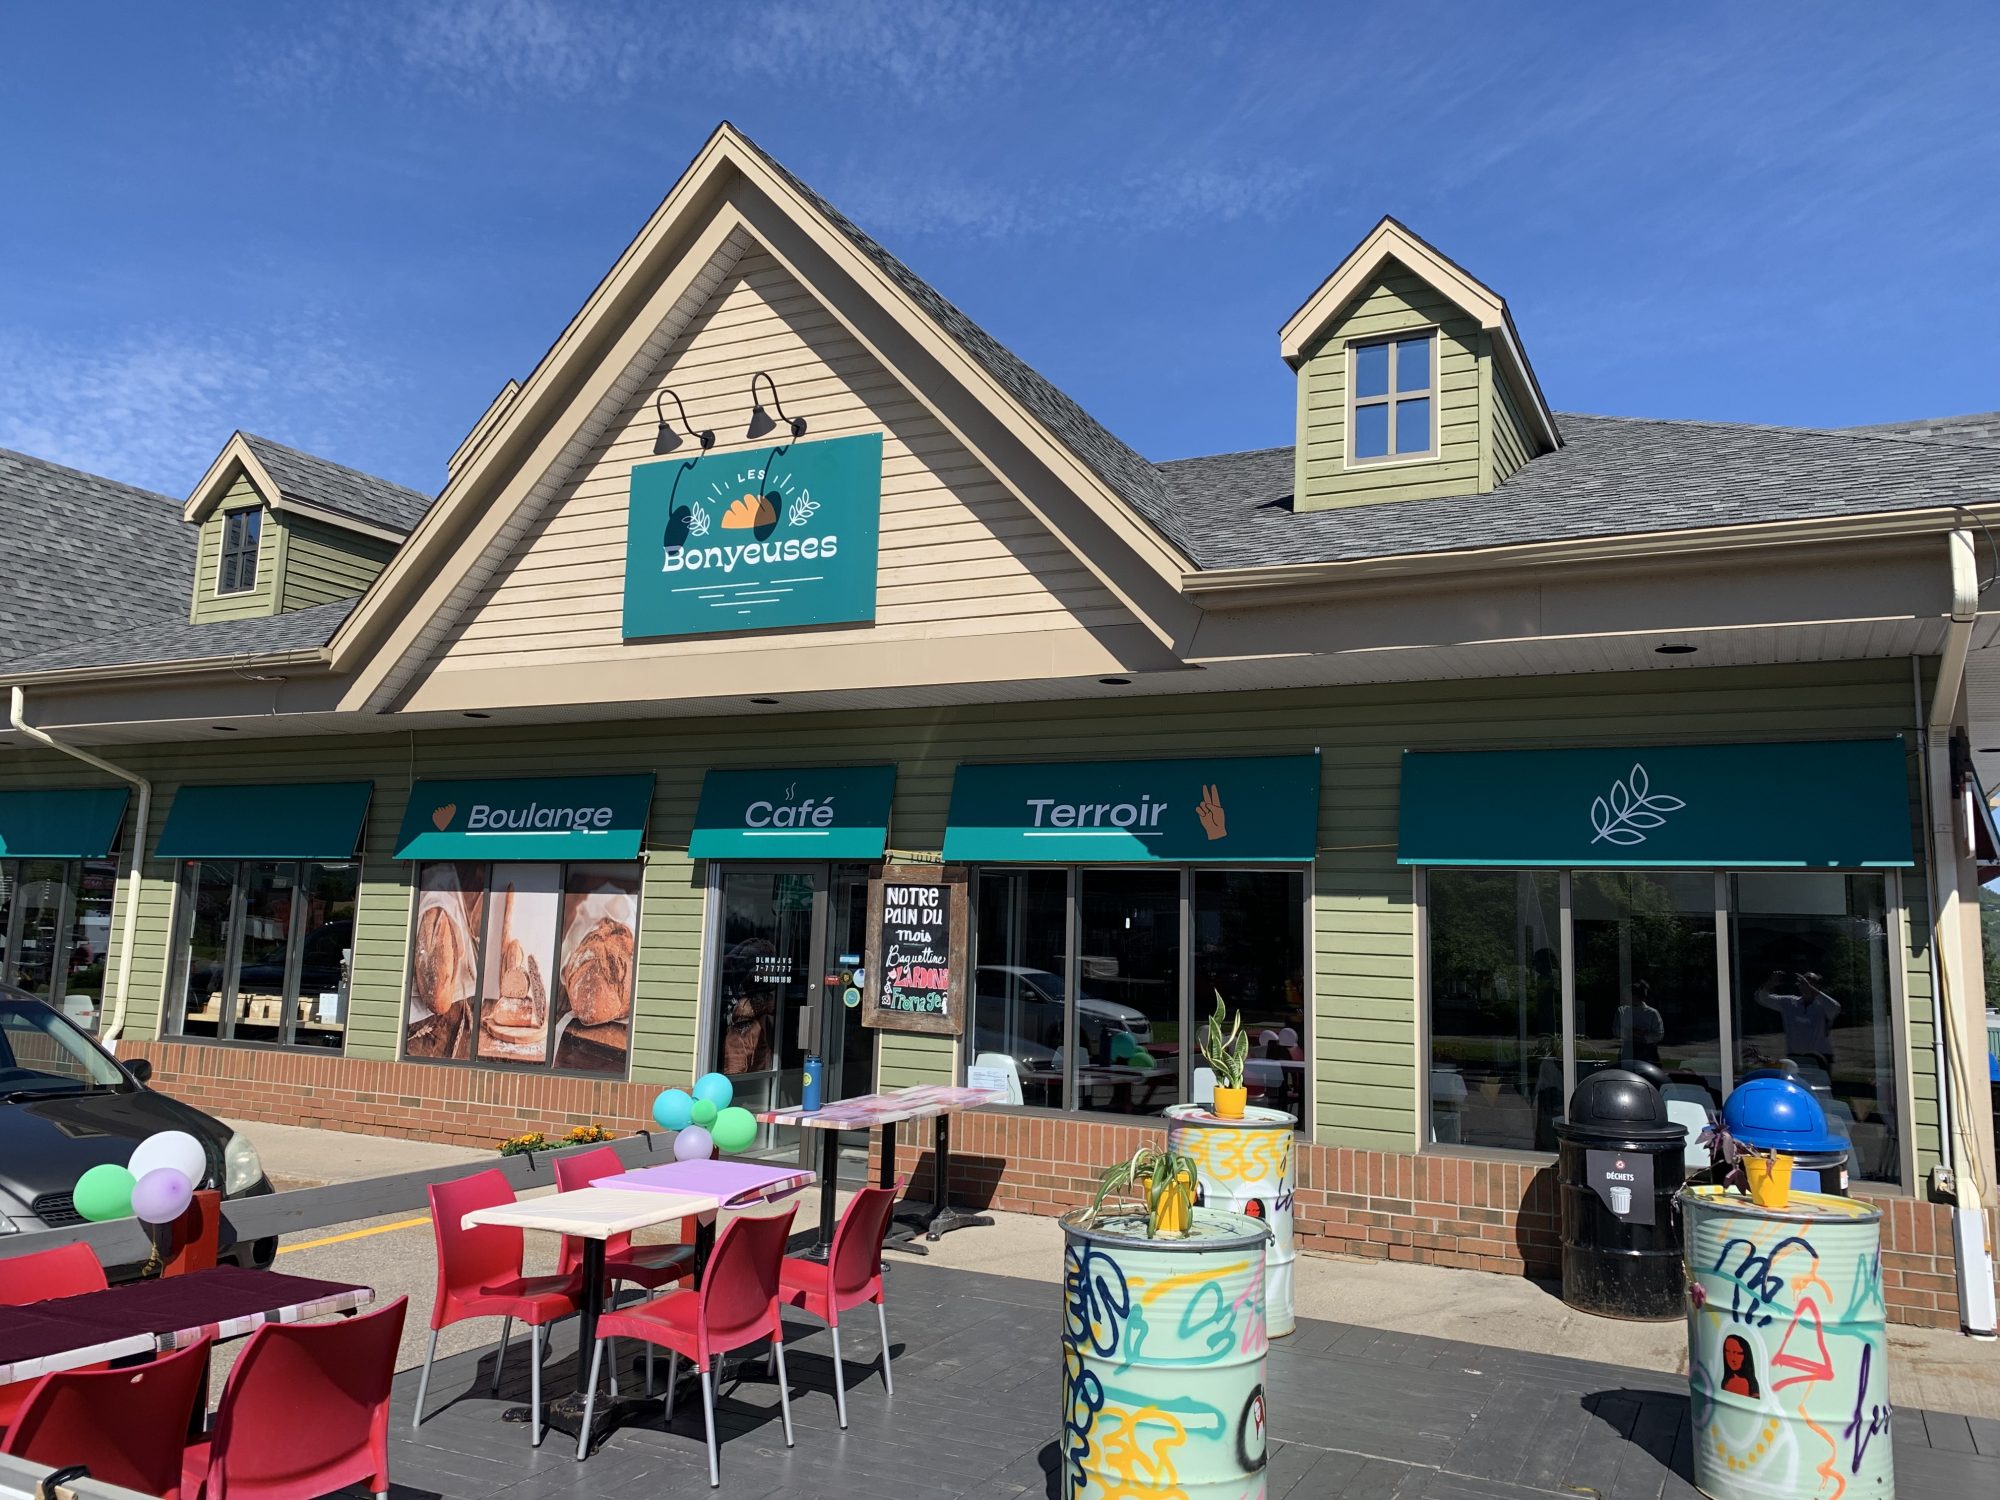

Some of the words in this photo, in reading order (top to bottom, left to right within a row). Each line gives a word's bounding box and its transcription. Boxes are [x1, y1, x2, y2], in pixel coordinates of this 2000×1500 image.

[737, 469, 766, 483] LES
[661, 535, 838, 573] Bonyeuses
[467, 802, 613, 833] Boulange
[744, 796, 834, 828] Café
[1026, 794, 1168, 828] Terroir
[922, 908, 943, 925] DU
[895, 929, 932, 943] mois
[1606, 1171, 1635, 1182] DÉCHETS
